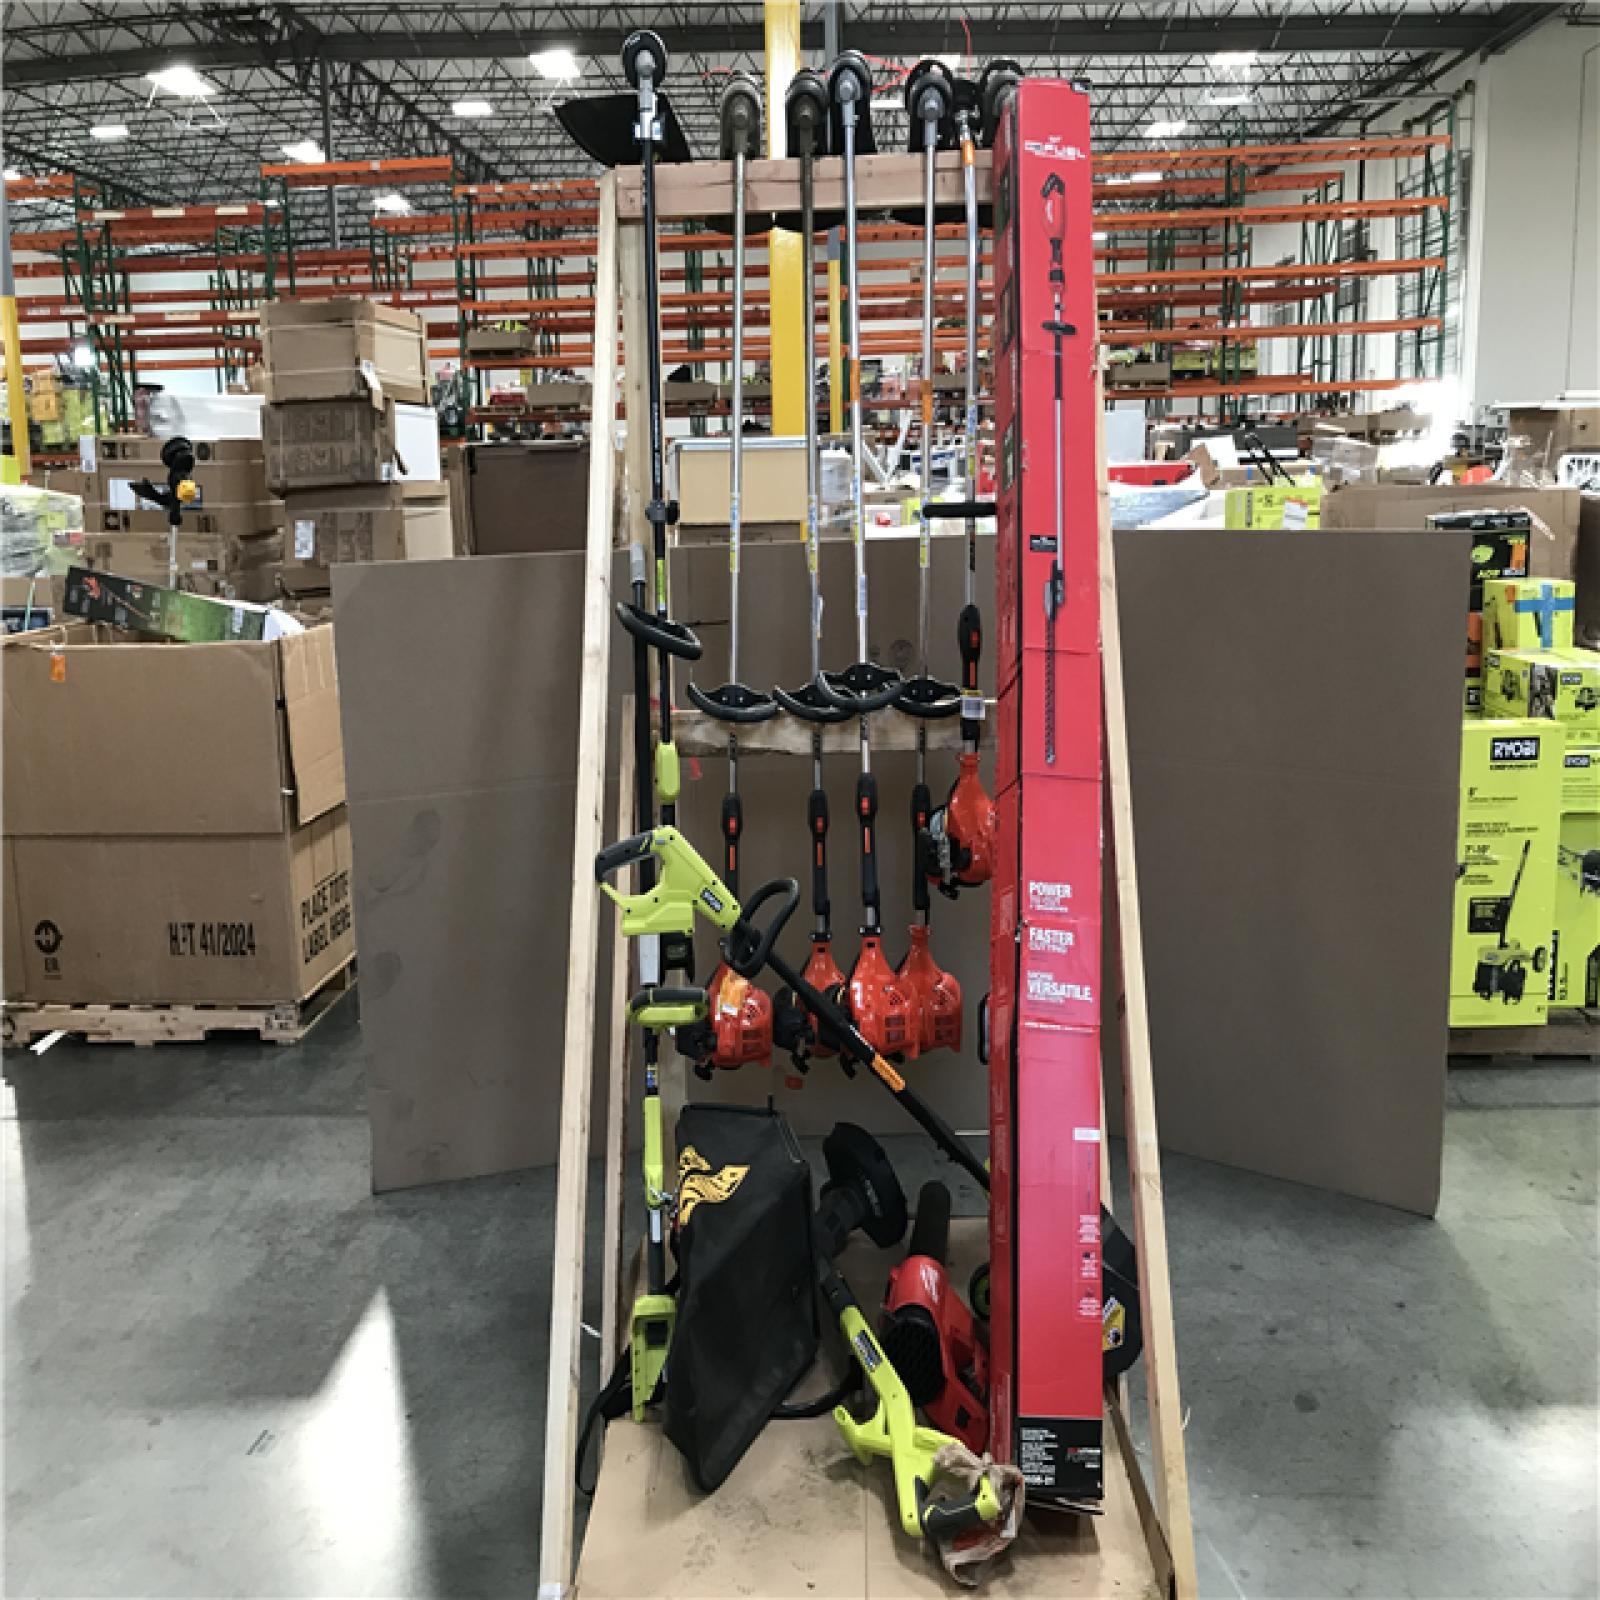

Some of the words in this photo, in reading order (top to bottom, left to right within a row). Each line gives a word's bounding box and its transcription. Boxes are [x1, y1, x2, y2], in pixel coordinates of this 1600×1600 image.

[1493, 740, 1536, 759] RYOBI
[1029, 881, 1072, 898] POWER
[302, 921, 330, 965] LABEL
[1029, 927, 1074, 946] FASTER
